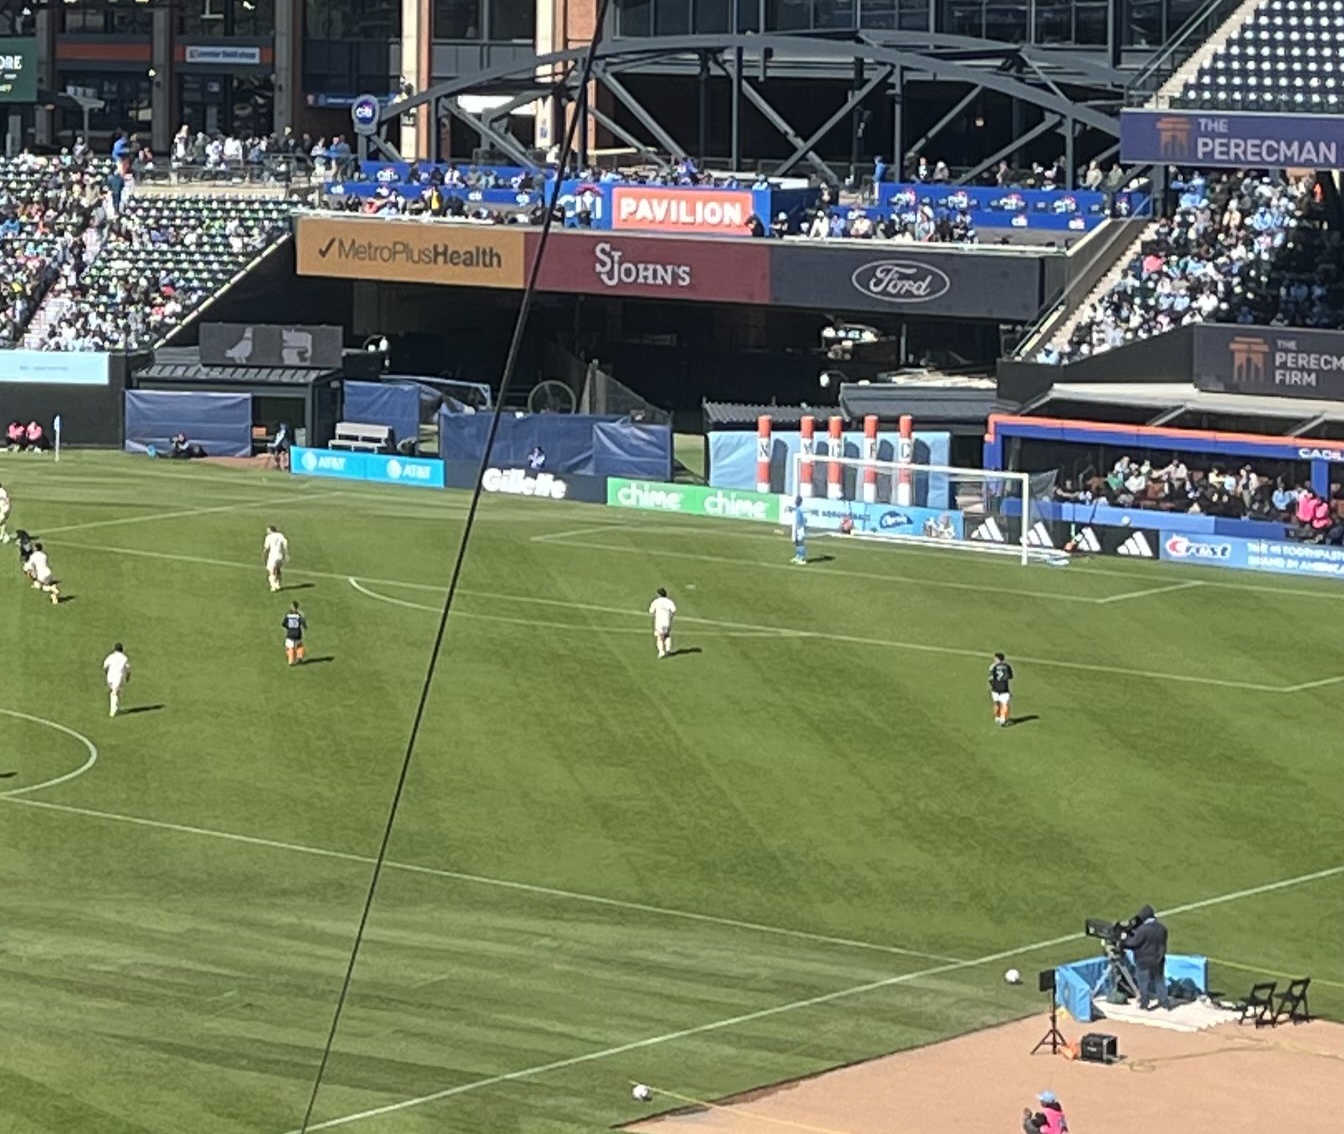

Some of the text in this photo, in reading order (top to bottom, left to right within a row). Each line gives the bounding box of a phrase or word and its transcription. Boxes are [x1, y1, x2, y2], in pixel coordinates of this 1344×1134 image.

[1198, 119, 1229, 133] THE
[1197, 137, 1337, 164] PERECMAN
[619, 197, 743, 226] PAVILION
[868, 264, 933, 298] Ford
[1277, 340, 1297, 351] THE
[1275, 370, 1317, 386] FIRM
[318, 455, 346, 470] AT&T
[402, 464, 431, 479] AT&T
[617, 482, 682, 512] chime
[704, 490, 769, 519] chime
